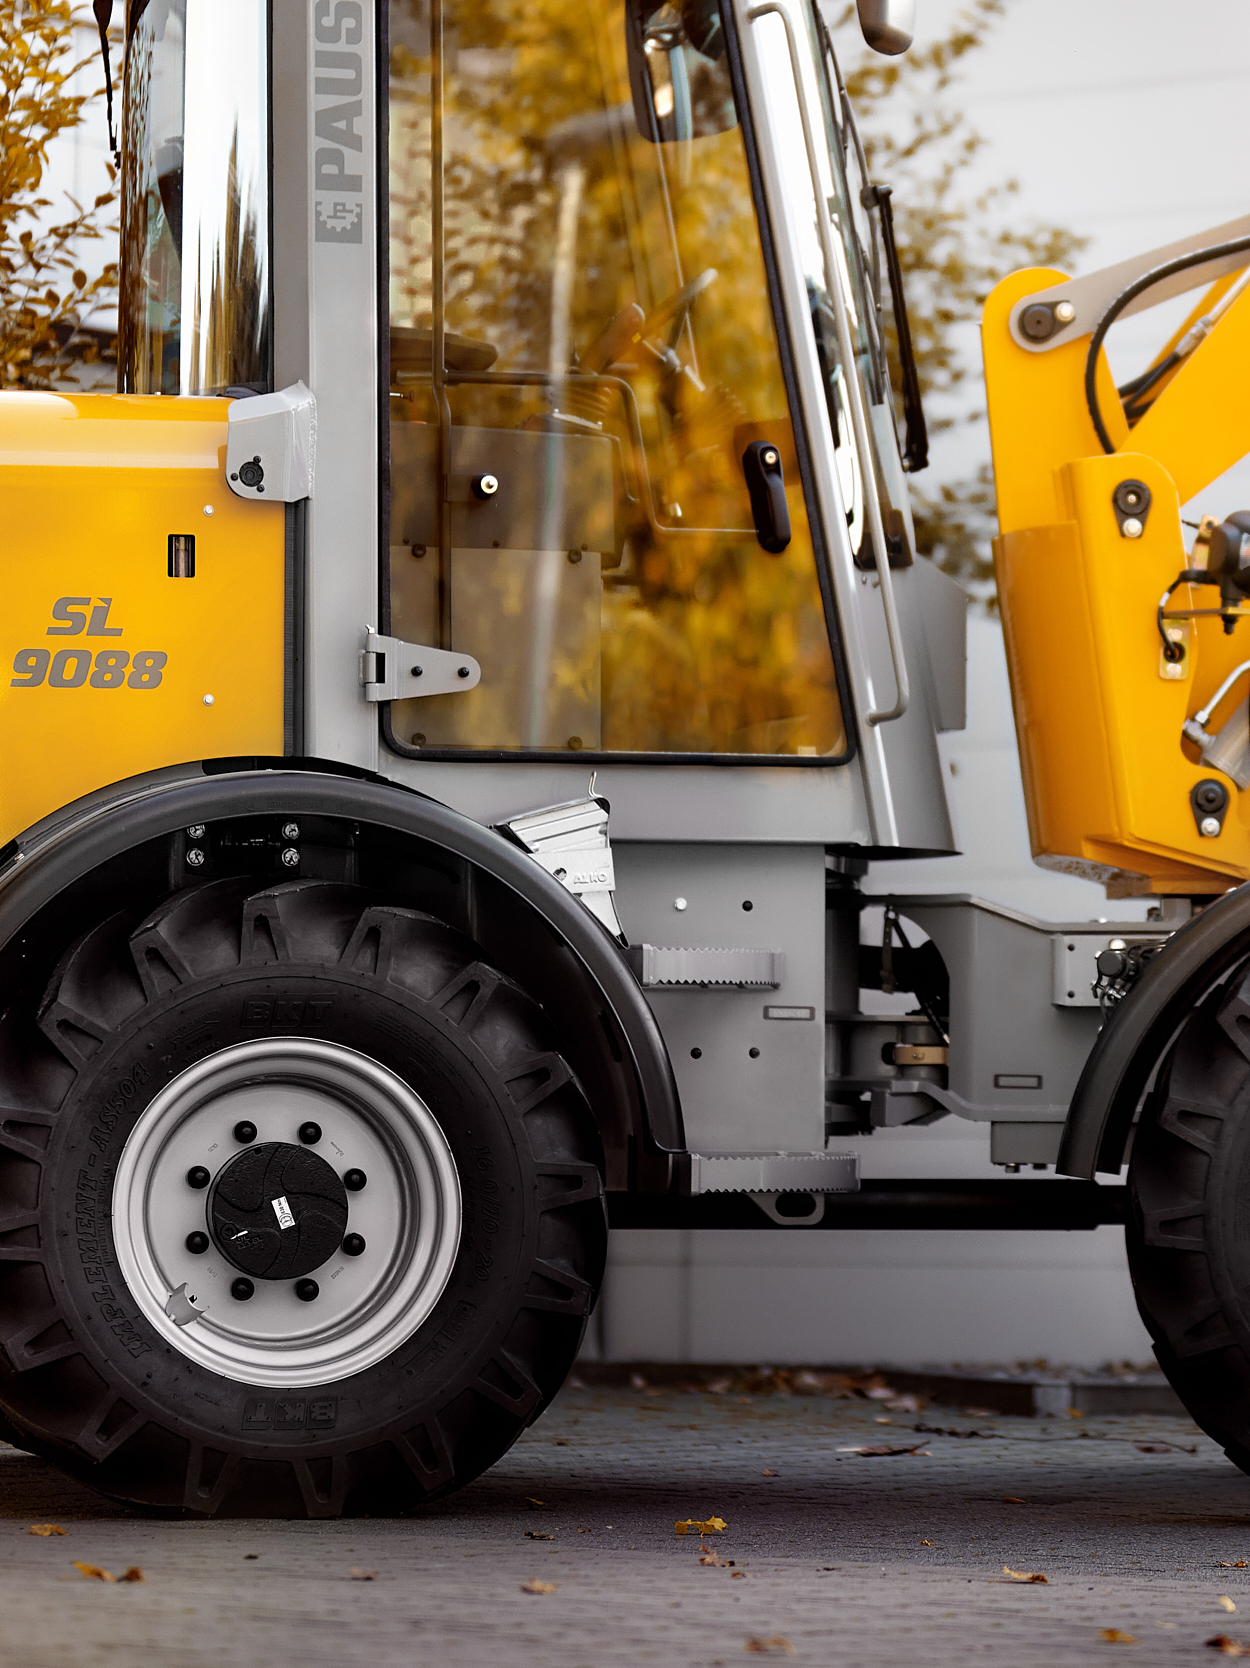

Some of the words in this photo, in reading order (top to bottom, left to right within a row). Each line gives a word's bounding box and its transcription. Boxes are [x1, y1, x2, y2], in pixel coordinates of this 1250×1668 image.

[315, 0, 363, 192] PAUS
[46, 596, 123, 636] SL
[10, 648, 168, 689] 9088
[244, 998, 335, 1025] BKT
[244, 1399, 337, 1426] BKT
